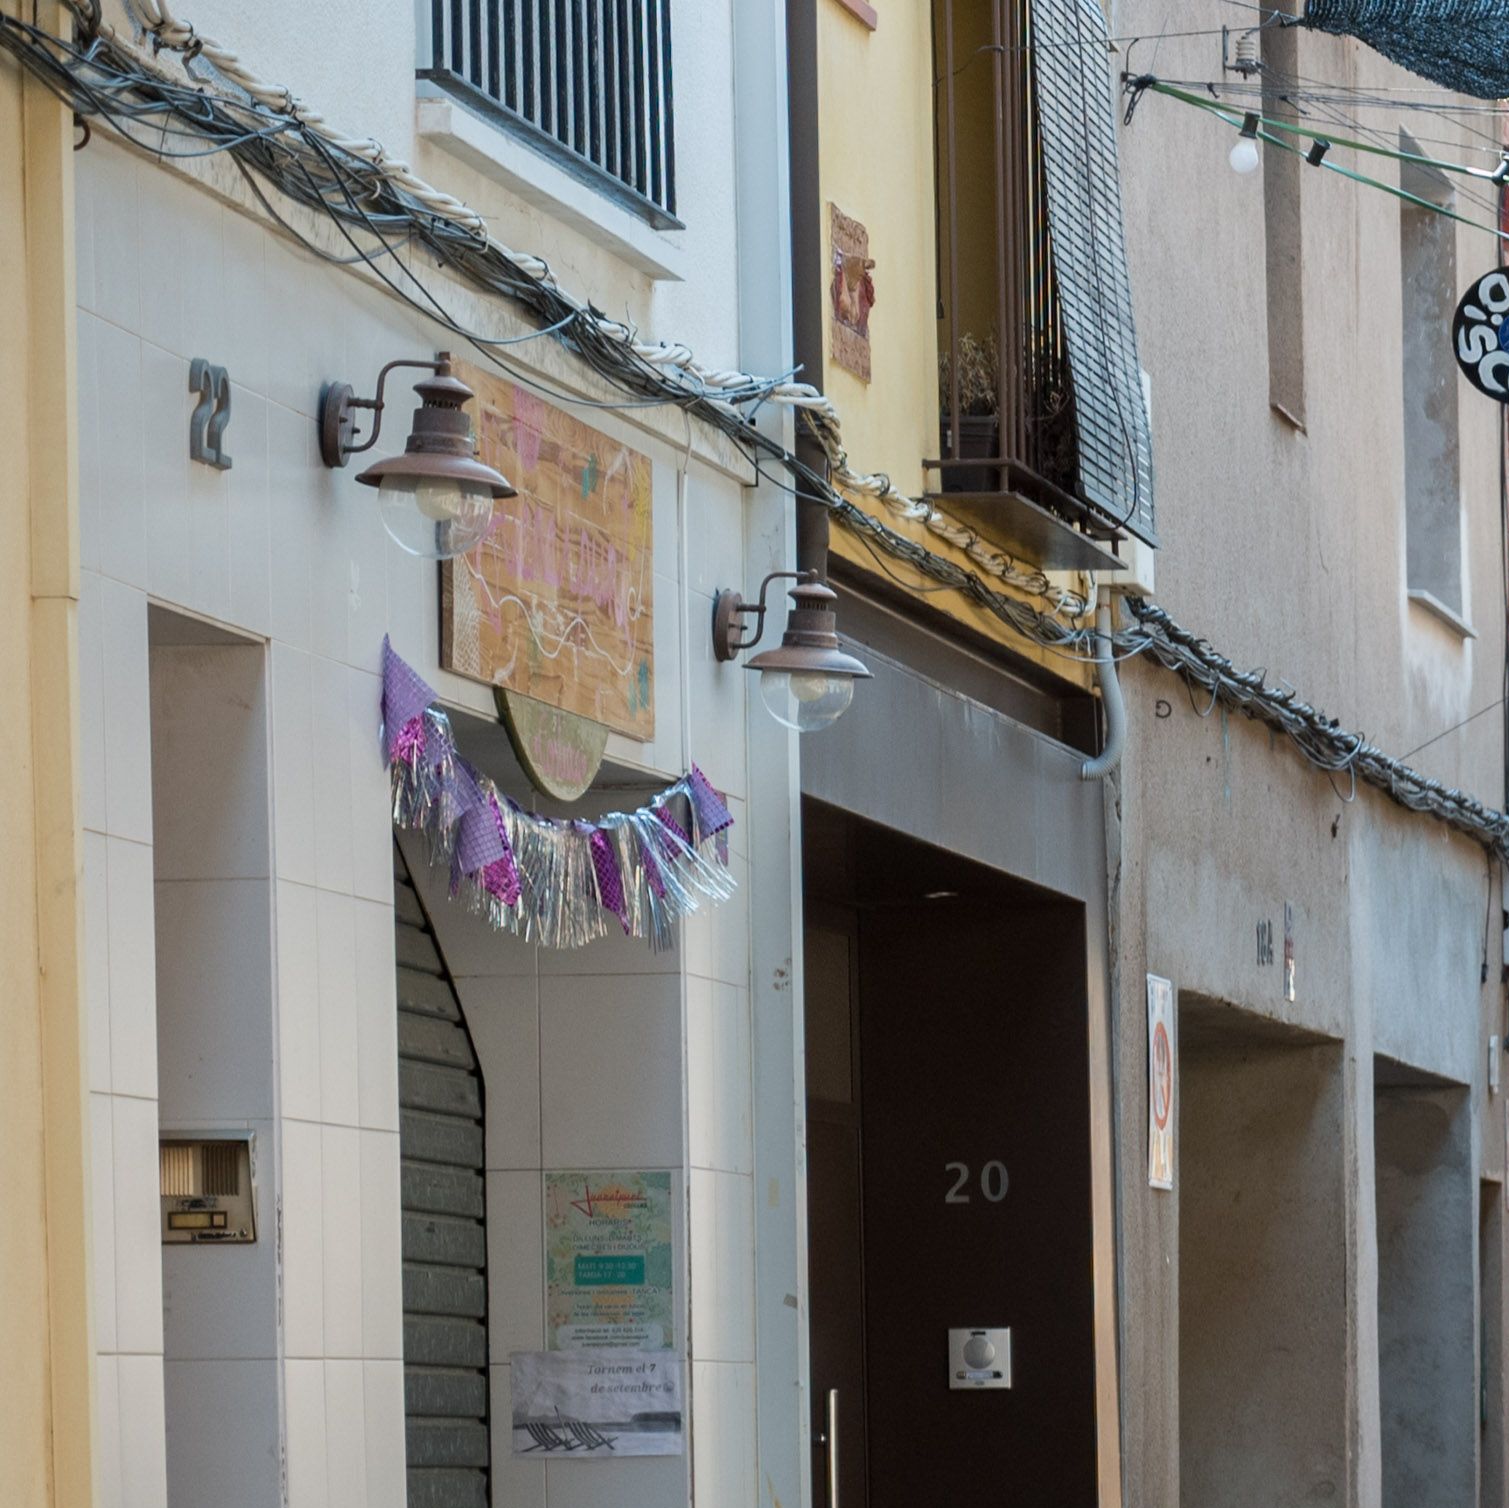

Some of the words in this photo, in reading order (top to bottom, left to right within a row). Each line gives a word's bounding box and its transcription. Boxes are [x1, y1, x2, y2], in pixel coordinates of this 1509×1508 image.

[189, 357, 232, 471] 22
[945, 1160, 1009, 1203] 20
[588, 1364, 633, 1375] Tornem
[636, 1363, 646, 1374] el
[650, 1363, 656, 1373] 7
[590, 1383, 603, 1394] de
[607, 1382, 662, 1393] setembre
